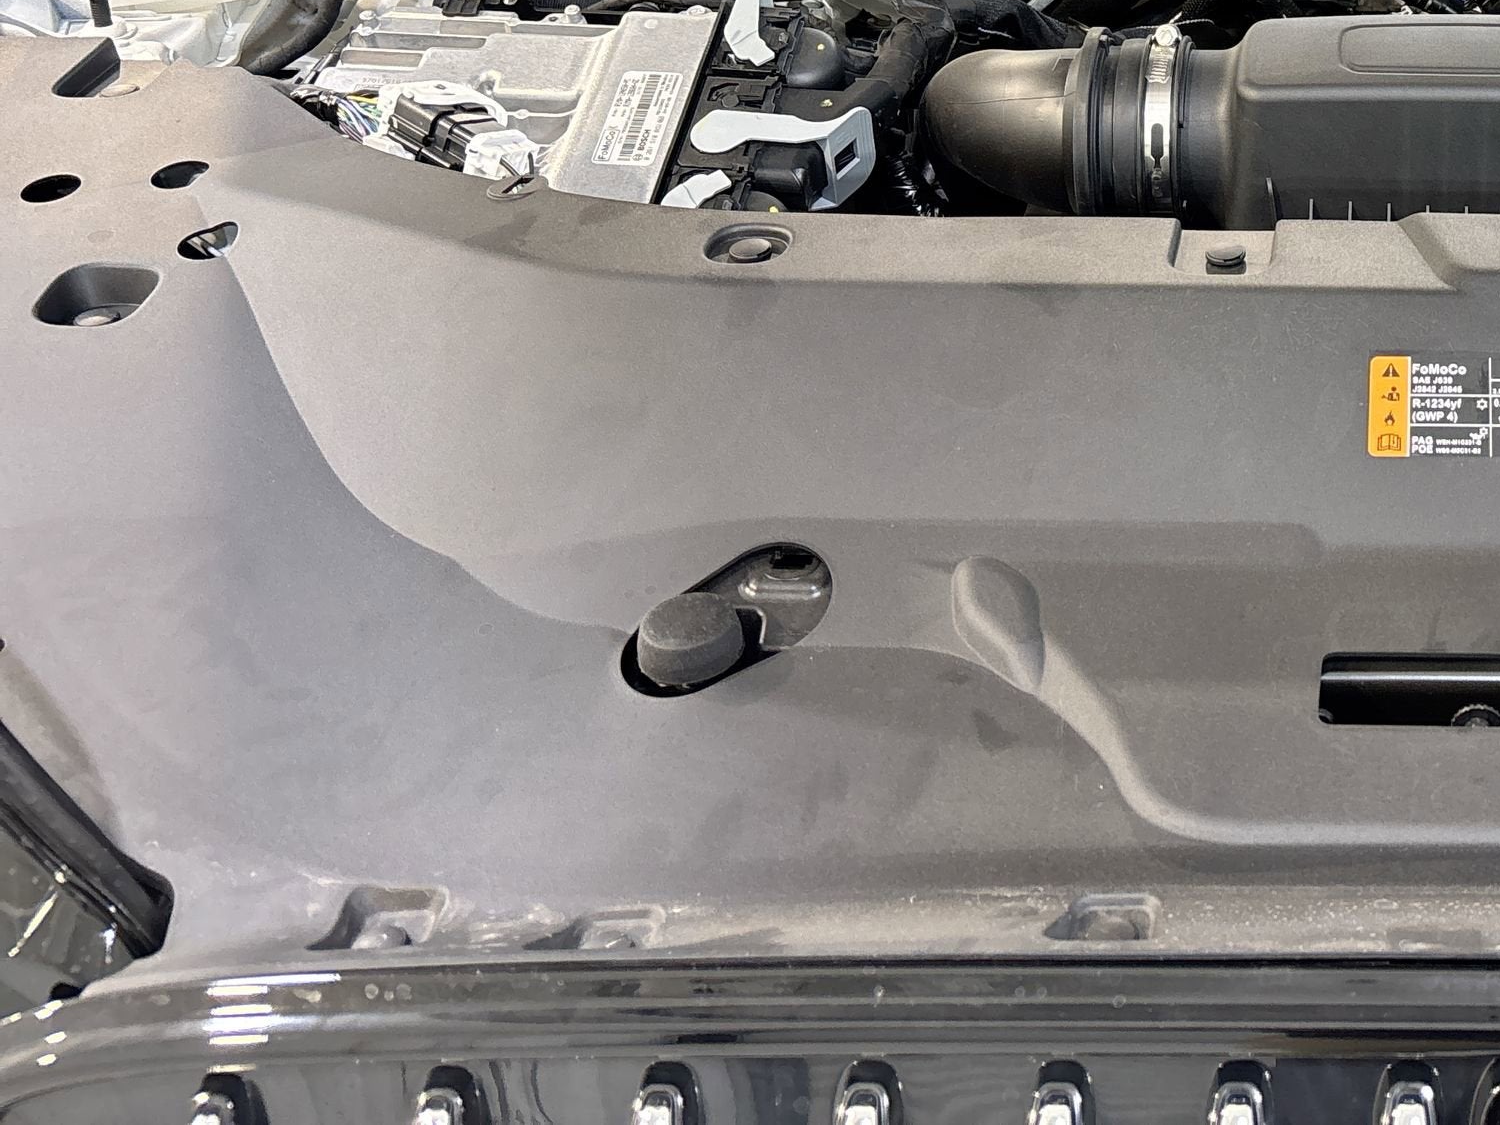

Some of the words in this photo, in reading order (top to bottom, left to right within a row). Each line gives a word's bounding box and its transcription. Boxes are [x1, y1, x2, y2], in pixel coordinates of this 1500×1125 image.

[598, 130, 616, 160] FoMoCo
[637, 129, 651, 151] BOSCH
[1412, 363, 1467, 375] FoMoCo
[1412, 376, 1431, 384] SAE
[1433, 376, 1453, 384] J639
[1412, 385, 1437, 393] J2842
[1412, 398, 1462, 411] R-1234yf
[1411, 411, 1445, 423] (GWP
[1446, 411, 1459, 424] 4)
[1411, 436, 1434, 445] PAG
[1411, 444, 1434, 454] POE
